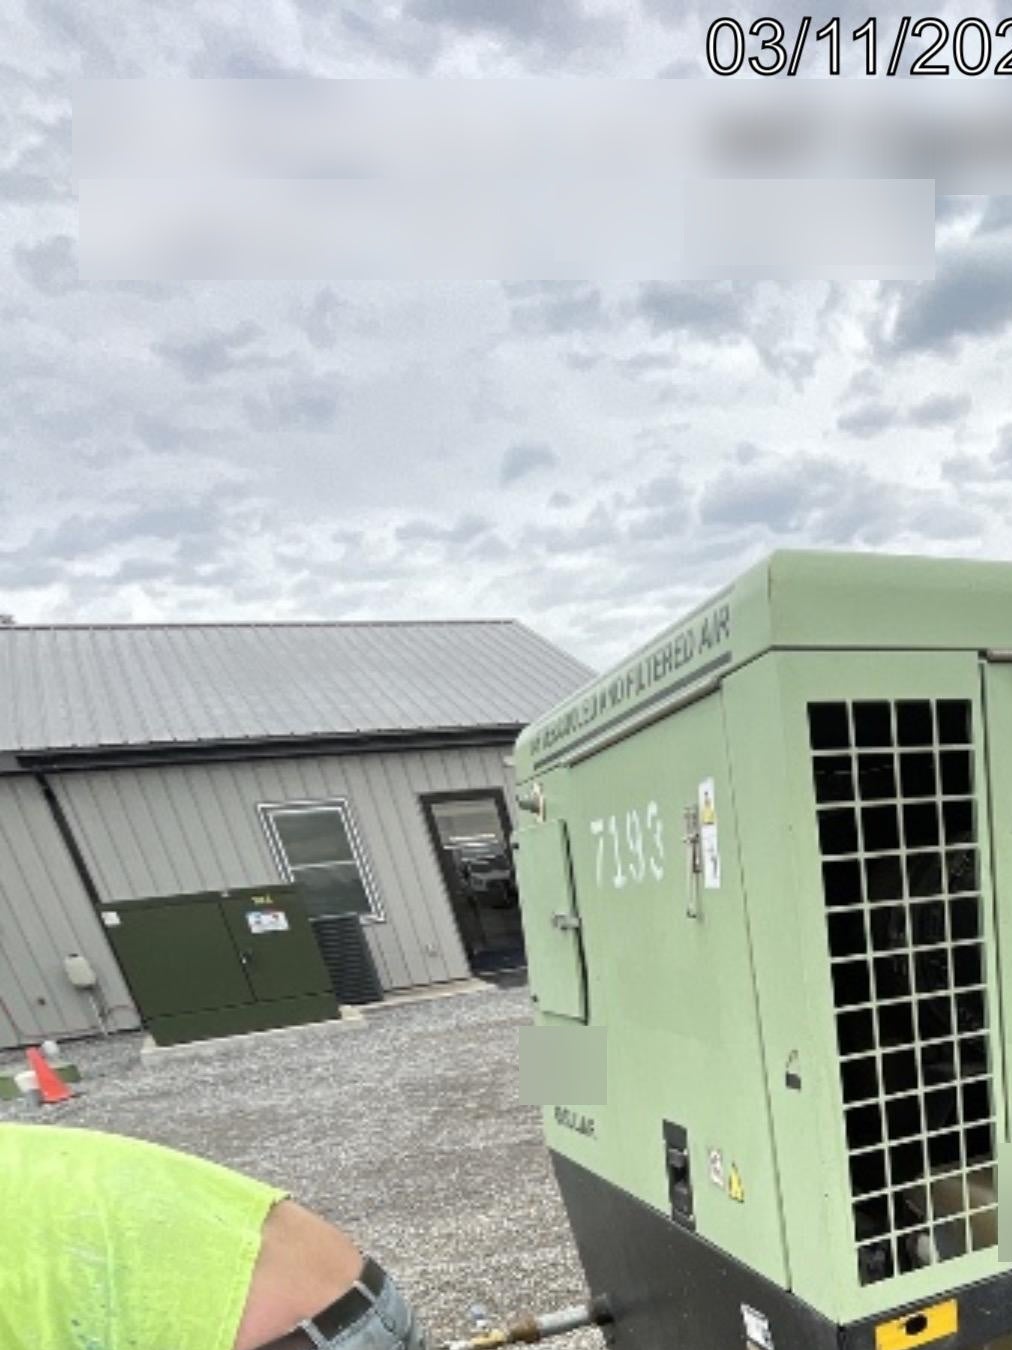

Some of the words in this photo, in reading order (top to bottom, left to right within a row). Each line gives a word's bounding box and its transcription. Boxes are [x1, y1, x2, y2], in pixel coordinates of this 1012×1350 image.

[626, 628, 694, 697] FILTERED
[698, 602, 731, 655] AIR
[590, 799, 664, 889] 7193
